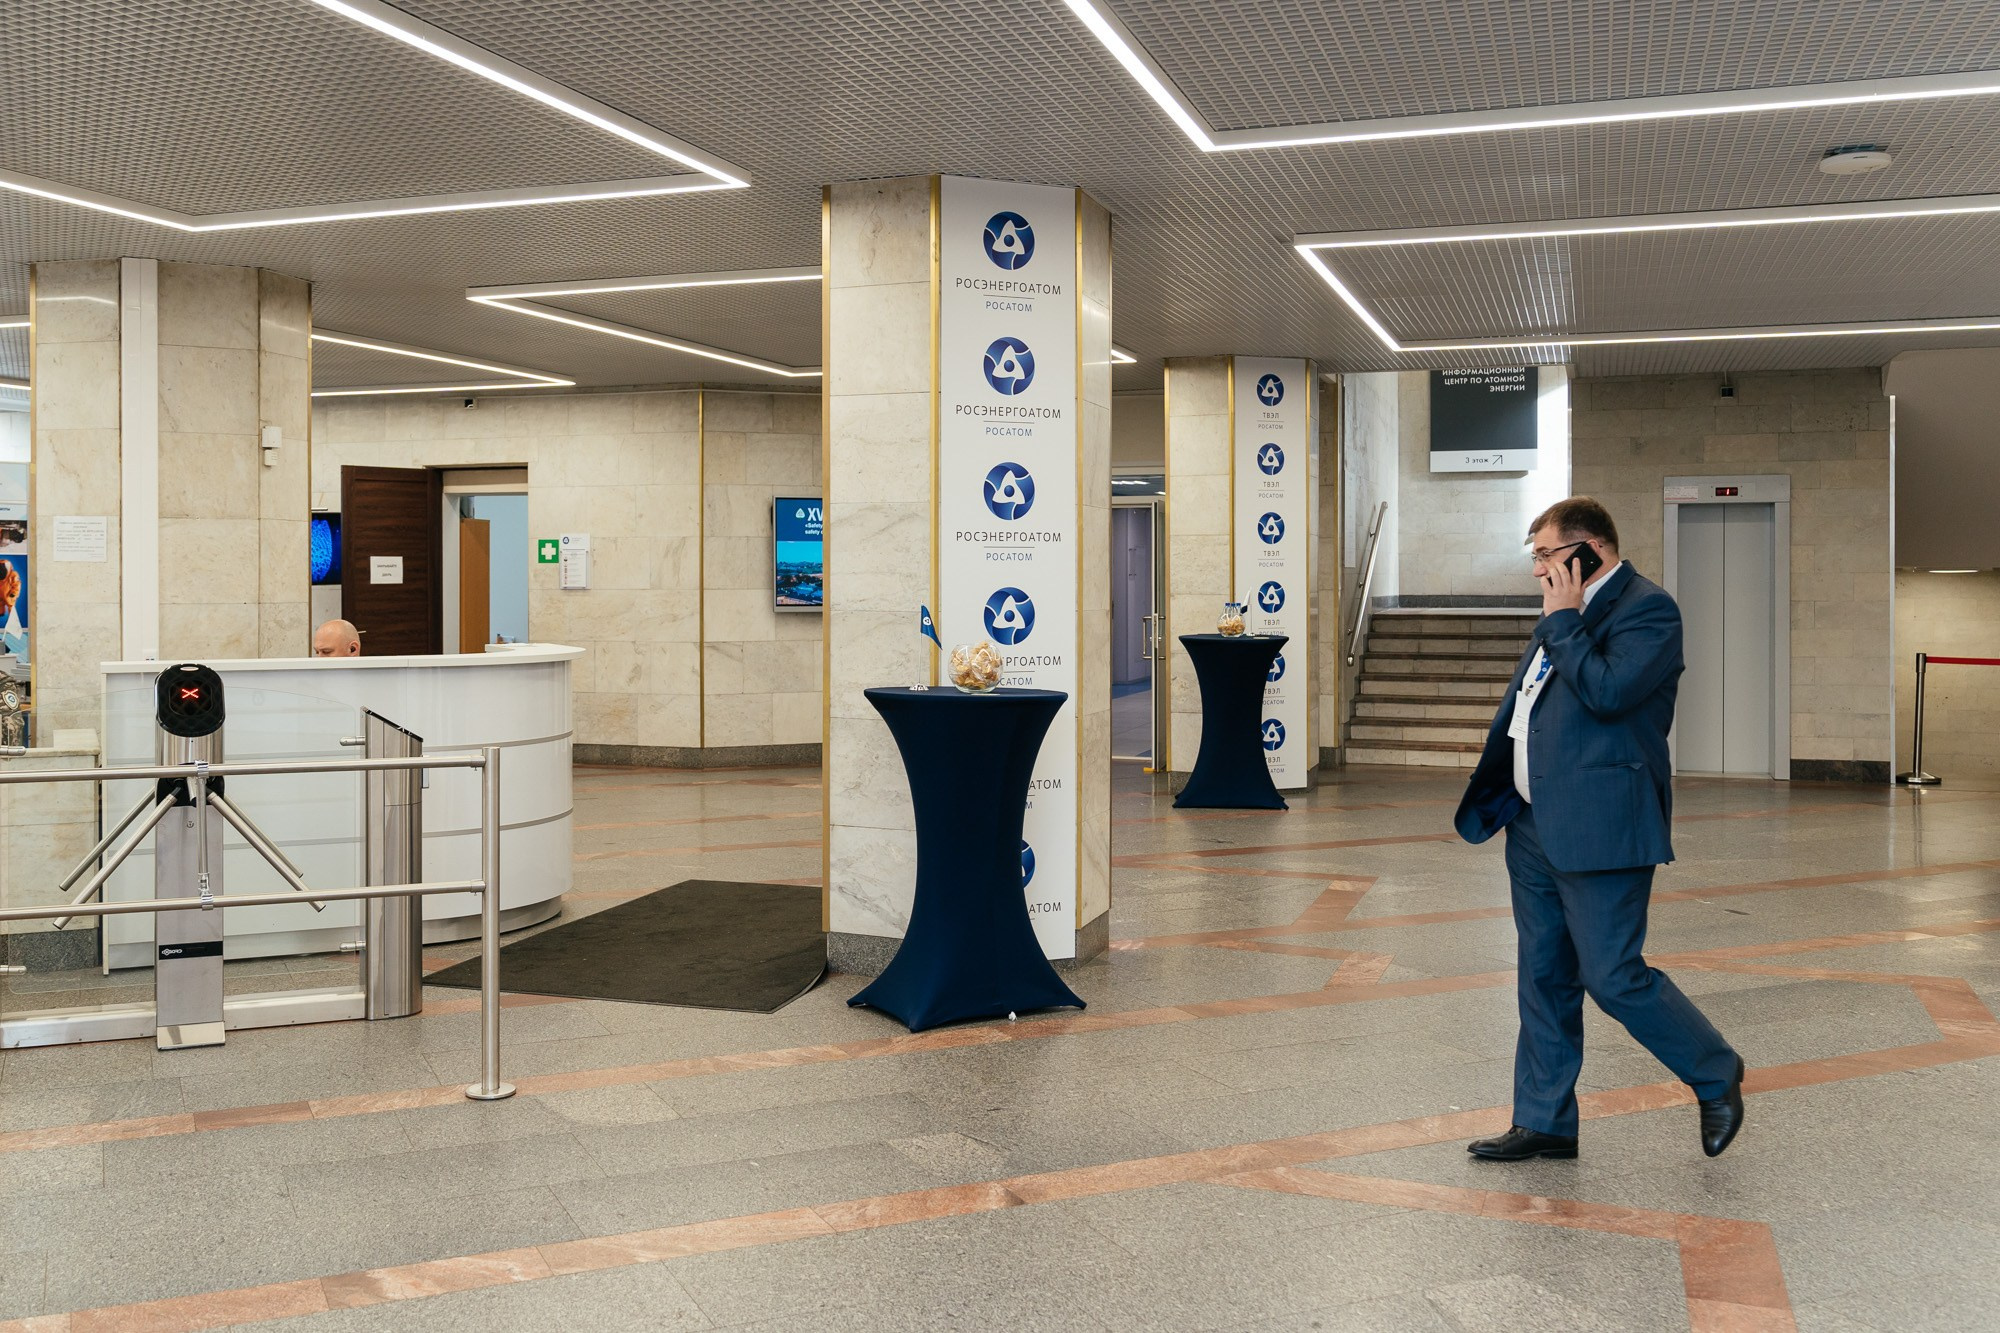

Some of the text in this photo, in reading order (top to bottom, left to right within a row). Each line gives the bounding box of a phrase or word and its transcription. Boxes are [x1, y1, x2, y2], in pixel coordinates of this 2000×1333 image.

[956, 277, 1061, 295] РОСЭНЕРГОАТОМ
[985, 301, 1033, 312] РОСАТОМ
[1484, 374, 1525, 383] АТОМНОЙ
[1489, 384, 1525, 392] ЭНЕРГИИ
[956, 404, 1061, 419] РОСЭНЕРГОАТОМ
[985, 427, 1033, 437] РОСАТОМ
[956, 531, 1062, 543] РОСЭНЕРГОАТОМ
[986, 552, 1033, 561] РОСАТОМ
[1004, 655, 1062, 667] РГОАТОМ
[1000, 677, 1033, 686] САТОМ
